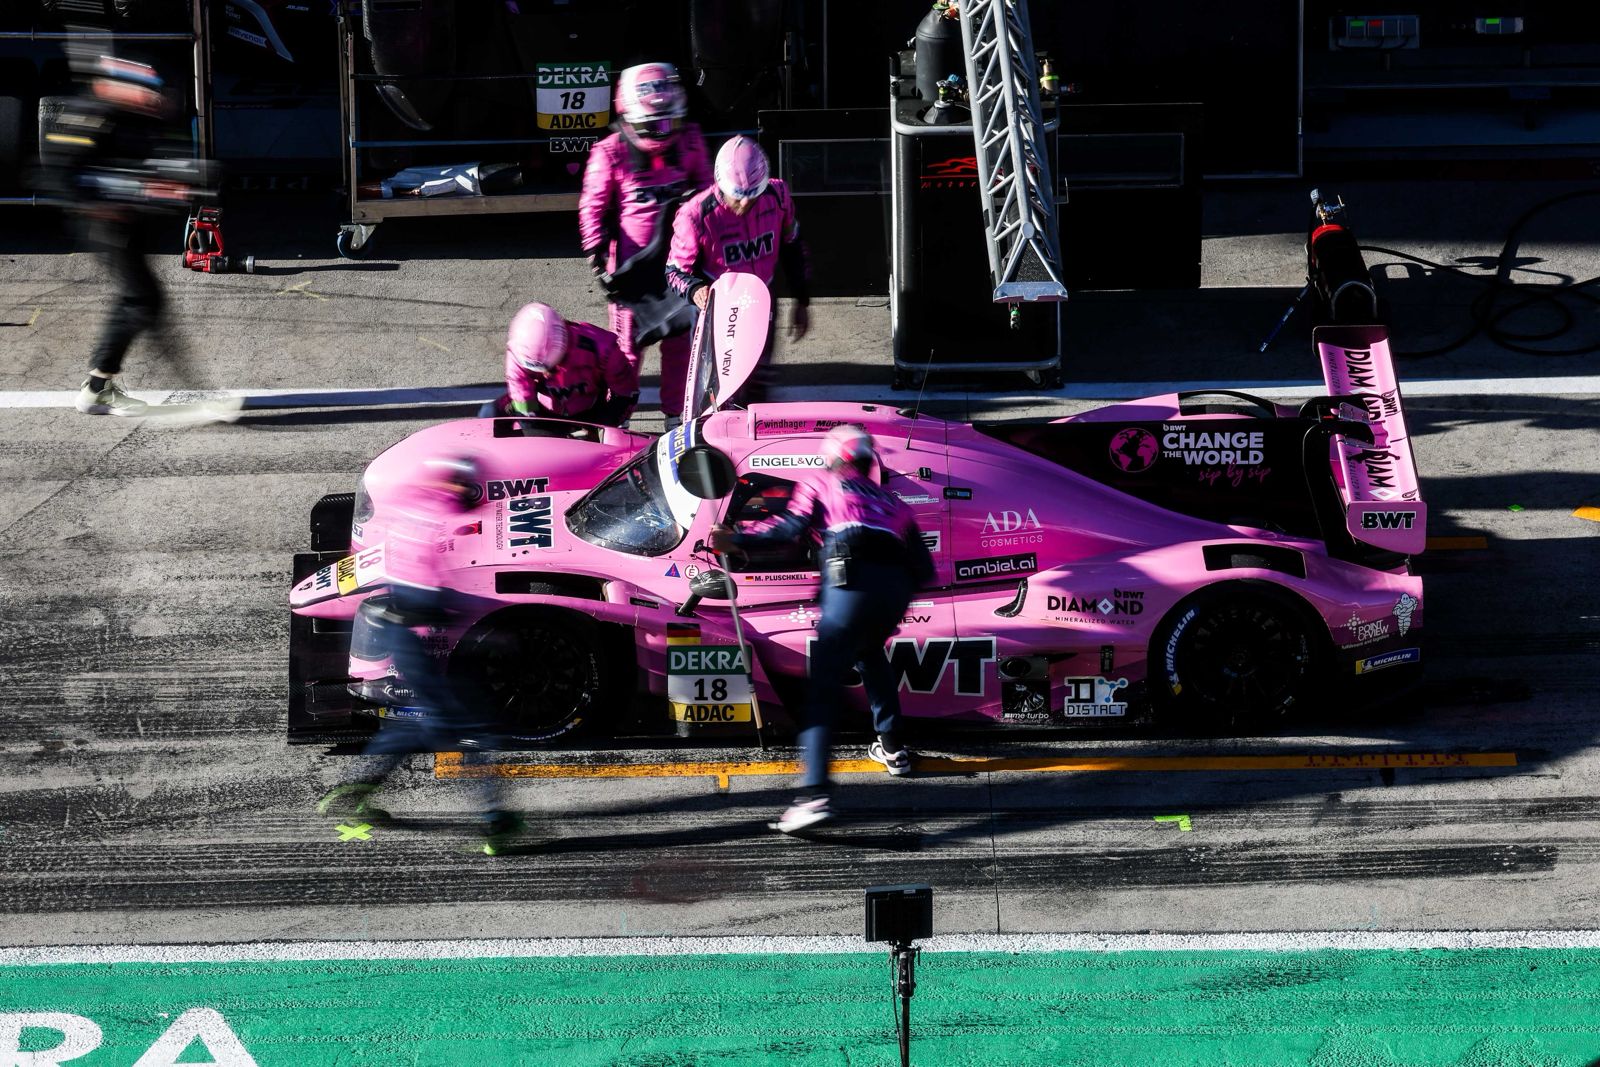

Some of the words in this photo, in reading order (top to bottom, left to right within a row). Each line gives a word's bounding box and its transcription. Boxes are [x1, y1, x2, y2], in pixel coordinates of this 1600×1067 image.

[538, 65, 609, 85] DEKRA
[559, 91, 586, 110] 18
[549, 114, 597, 129] ADAC
[549, 136, 599, 153] BWT
[723, 231, 775, 266] BWT
[722, 349, 733, 377] VIEW
[763, 419, 807, 430] windhager
[1162, 432, 1265, 449] CHANGE
[752, 456, 825, 467] ENGEL&VÖ
[1163, 450, 1182, 458] THE
[1183, 450, 1265, 465] WORLD
[486, 477, 549, 501] BWT
[507, 496, 554, 549] BWT
[980, 508, 1041, 535] ADA
[1361, 511, 1416, 530] BWT
[981, 534, 1044, 548] COSMETICS
[358, 548, 383, 569] 18
[958, 556, 1036, 577] ambiel.ai
[315, 566, 332, 591] BWT
[337, 557, 356, 583] ADAC
[765, 574, 809, 582] PLUSCHKELL
[1055, 616, 1106, 625] MINERALIZED
[1358, 619, 1384, 635] POINT
[1166, 608, 1197, 672] MICHELIN
[671, 651, 747, 670] DEKRA
[1373, 653, 1412, 666] MICHELIN
[694, 678, 728, 701] 18
[684, 705, 735, 722] ADAC
[1067, 704, 1126, 715] DISTACT
